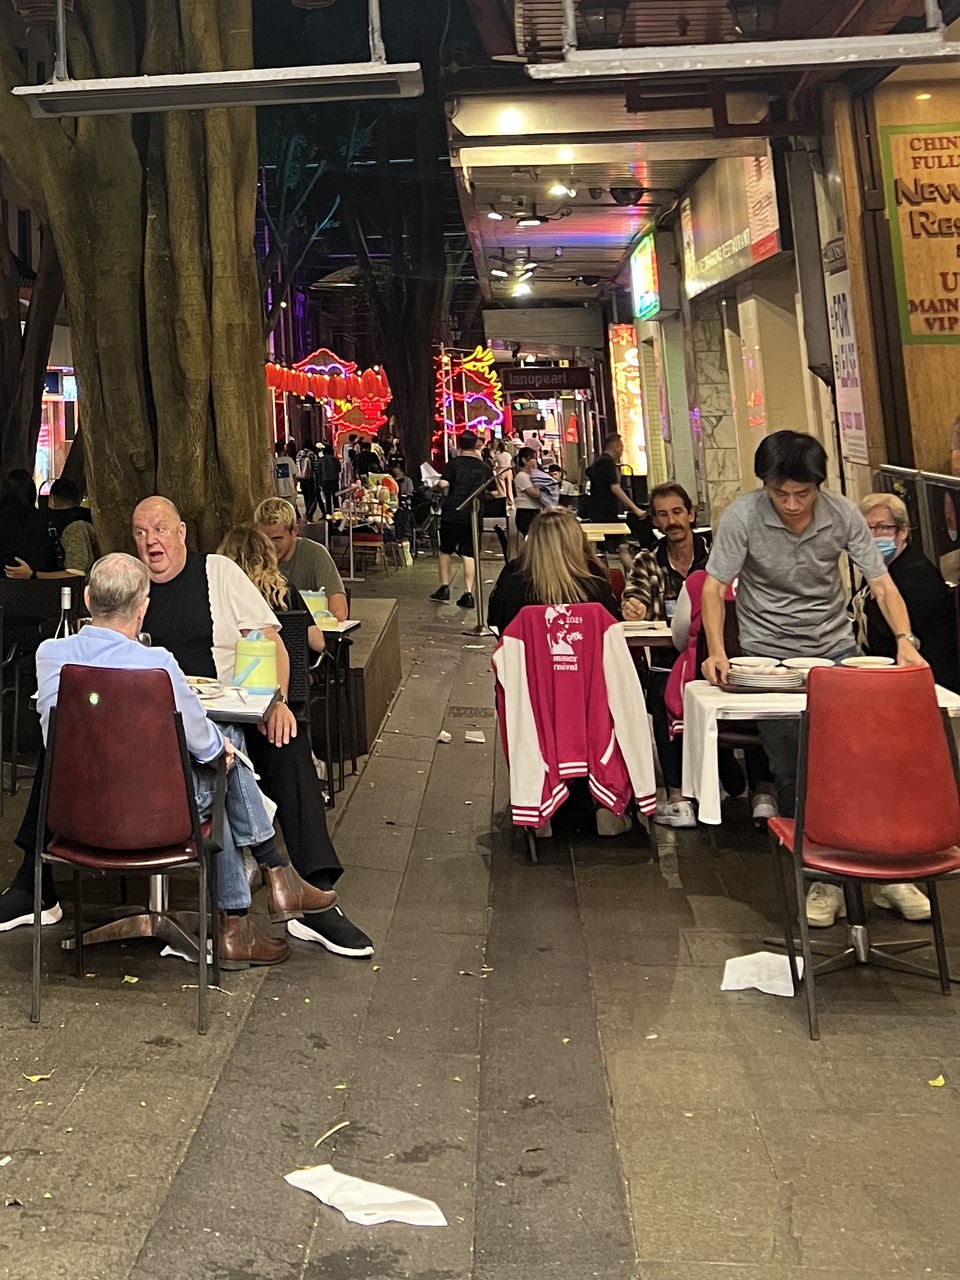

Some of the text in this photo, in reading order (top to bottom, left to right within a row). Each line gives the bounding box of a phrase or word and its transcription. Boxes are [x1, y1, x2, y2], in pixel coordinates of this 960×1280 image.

[909, 136, 960, 151] CHIN
[908, 298, 959, 315] MAIN
[832, 293, 851, 338] FOR
[924, 316, 959, 331] VIP
[508, 372, 567, 387] lanopearl
[553, 662, 578, 671] rnival
